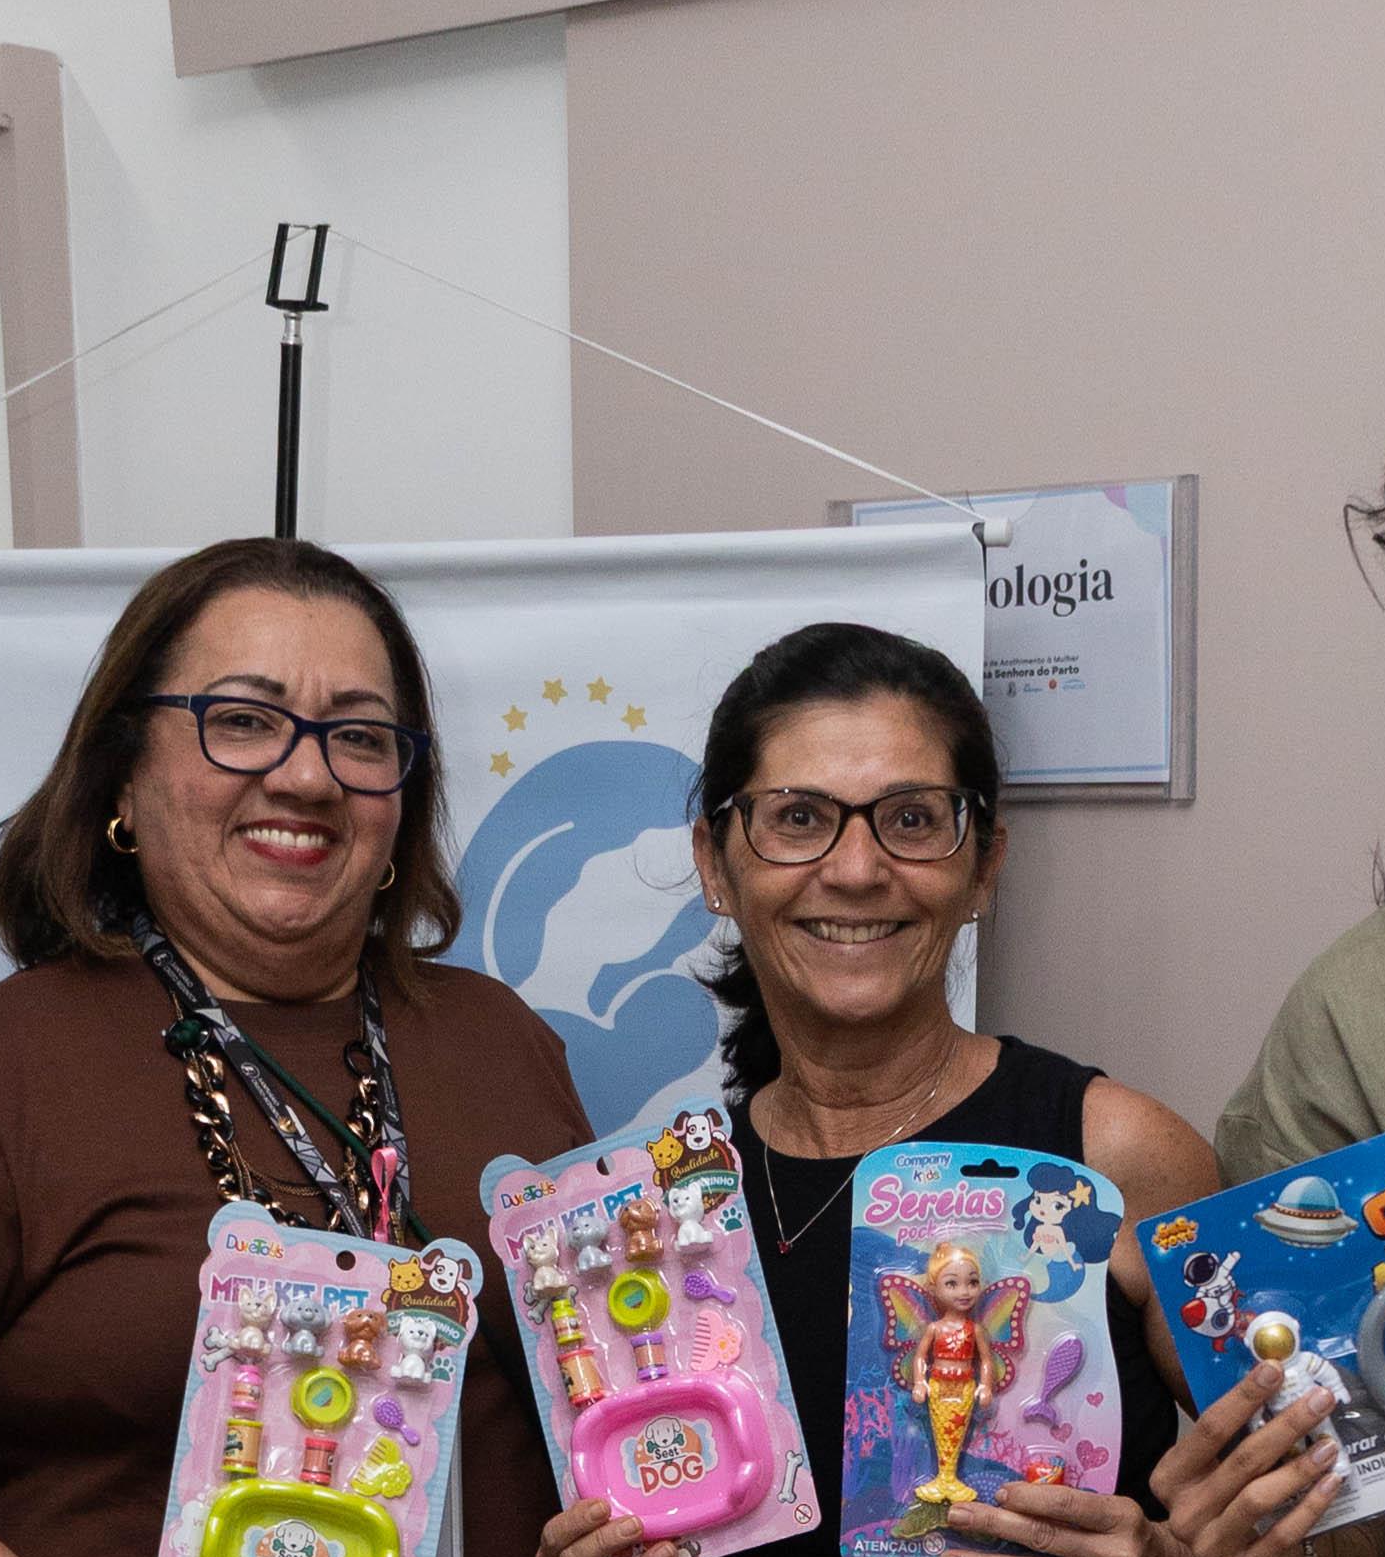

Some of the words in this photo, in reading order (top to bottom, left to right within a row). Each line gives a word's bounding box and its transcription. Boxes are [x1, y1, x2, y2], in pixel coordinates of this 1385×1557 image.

[986, 558, 1115, 617] ologia
[995, 667, 1035, 679] Senhora
[1037, 665, 1049, 677] do
[1051, 664, 1080, 676] Parto
[896, 1153, 951, 1168] Company
[864, 1175, 1005, 1225] Sereias
[654, 1446, 681, 1461] Seat
[639, 1454, 704, 1494] DOG
